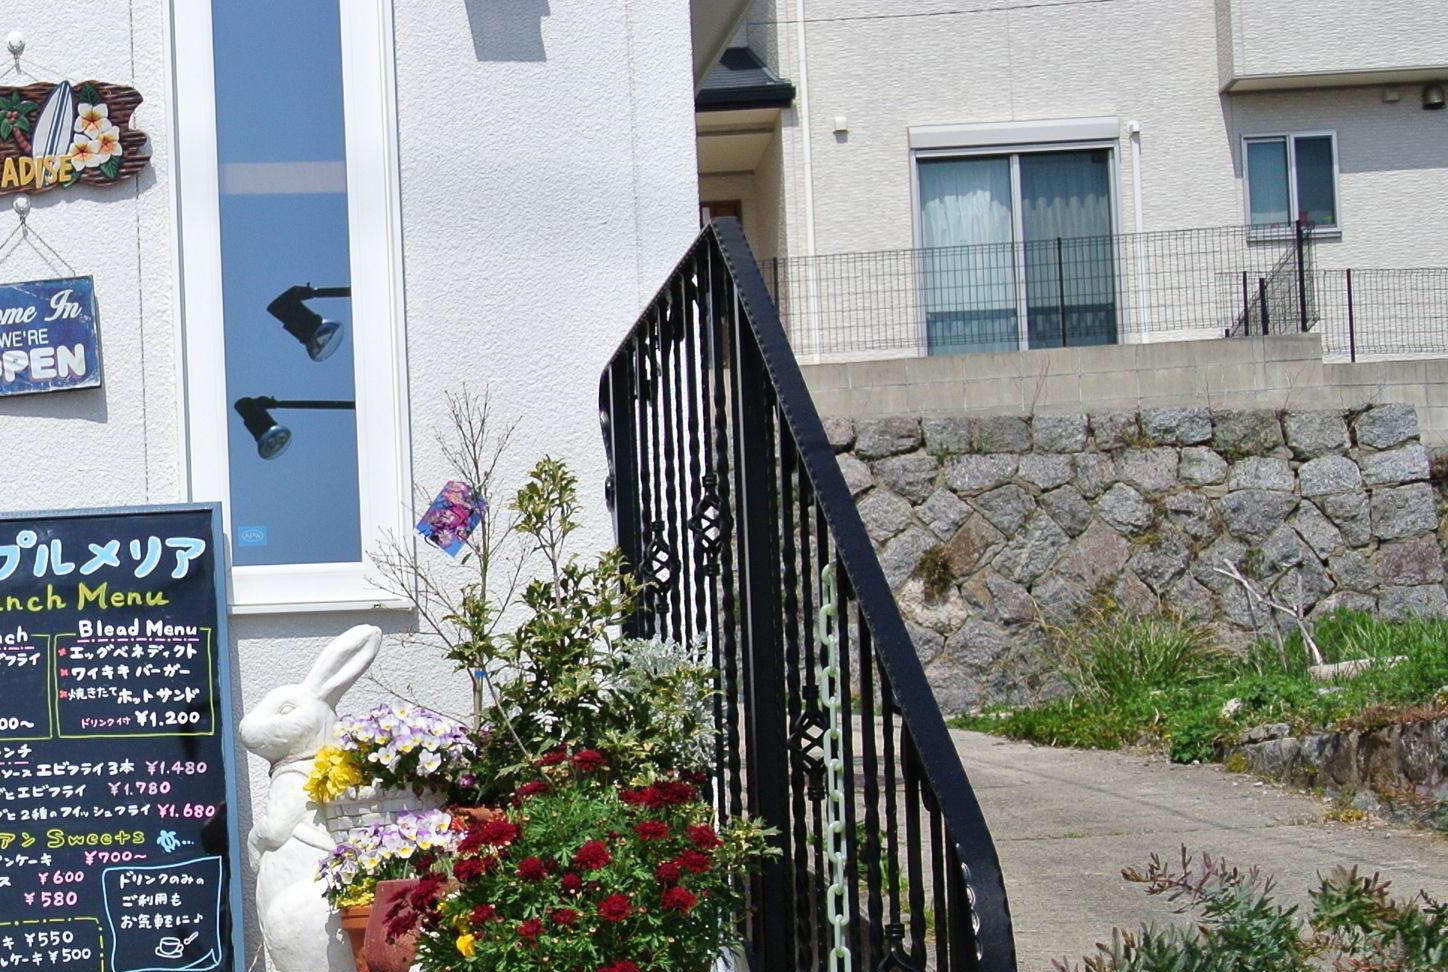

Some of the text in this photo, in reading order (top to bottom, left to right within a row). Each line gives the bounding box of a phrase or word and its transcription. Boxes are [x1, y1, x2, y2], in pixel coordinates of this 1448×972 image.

[44, 289, 83, 322] In
[77, 581, 170, 611] Menu
[78, 617, 198, 638] Blead Menu
[69, 643, 199, 660] エッグベネディクト
[146, 760, 208, 776] ¥1.480
[107, 780, 172, 797] ¥1.780
[157, 802, 216, 819] ¥1.680
[46, 828, 146, 849] Sweets
[119, 870, 205, 890] ドリンクのみの
[122, 892, 182, 908] ご利用も
[24, 930, 74, 948] ¥550
